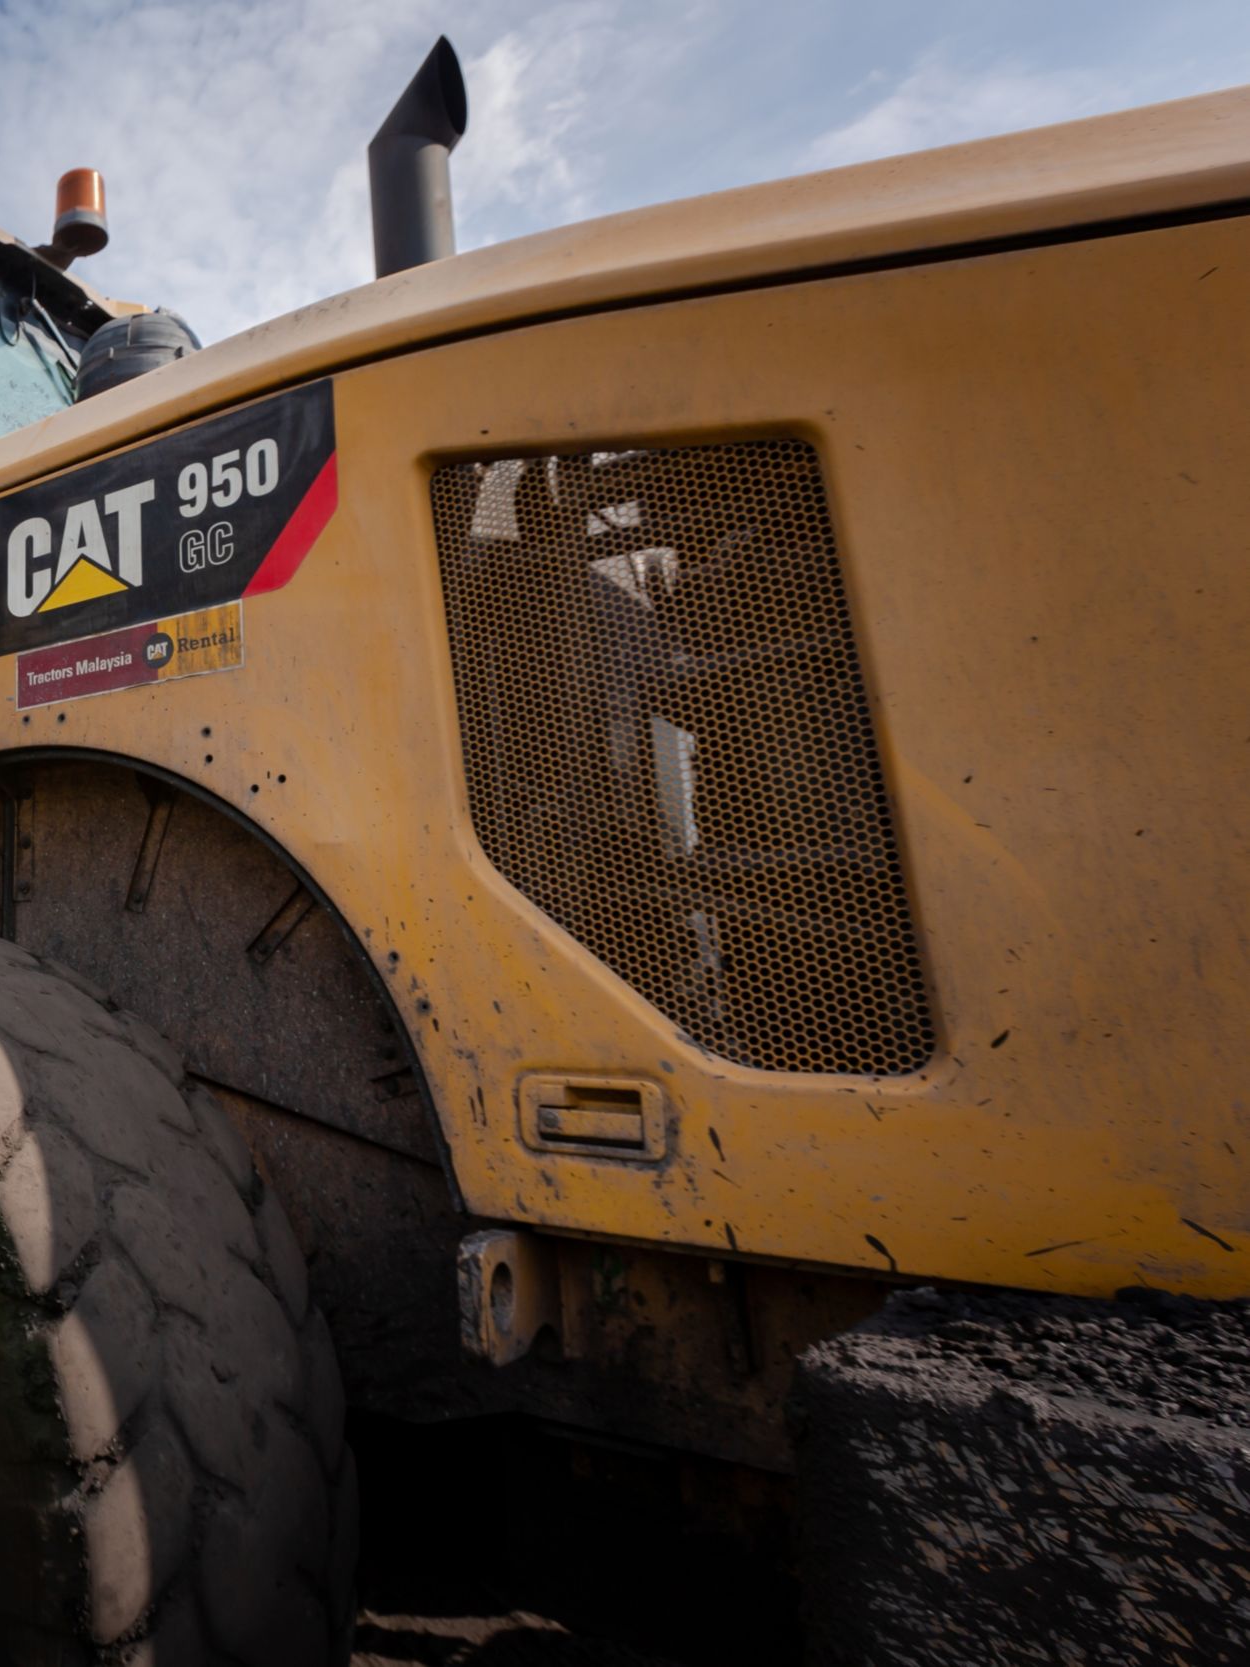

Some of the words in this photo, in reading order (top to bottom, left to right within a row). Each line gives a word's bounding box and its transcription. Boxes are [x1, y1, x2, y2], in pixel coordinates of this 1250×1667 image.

[7, 478, 155, 618] CAT
[177, 438, 279, 518] 950
[179, 521, 234, 573] GC
[26, 666, 73, 686] Tractors
[76, 652, 132, 677] Malaysia
[146, 640, 168, 661] CAT
[177, 627, 235, 654] Rental
